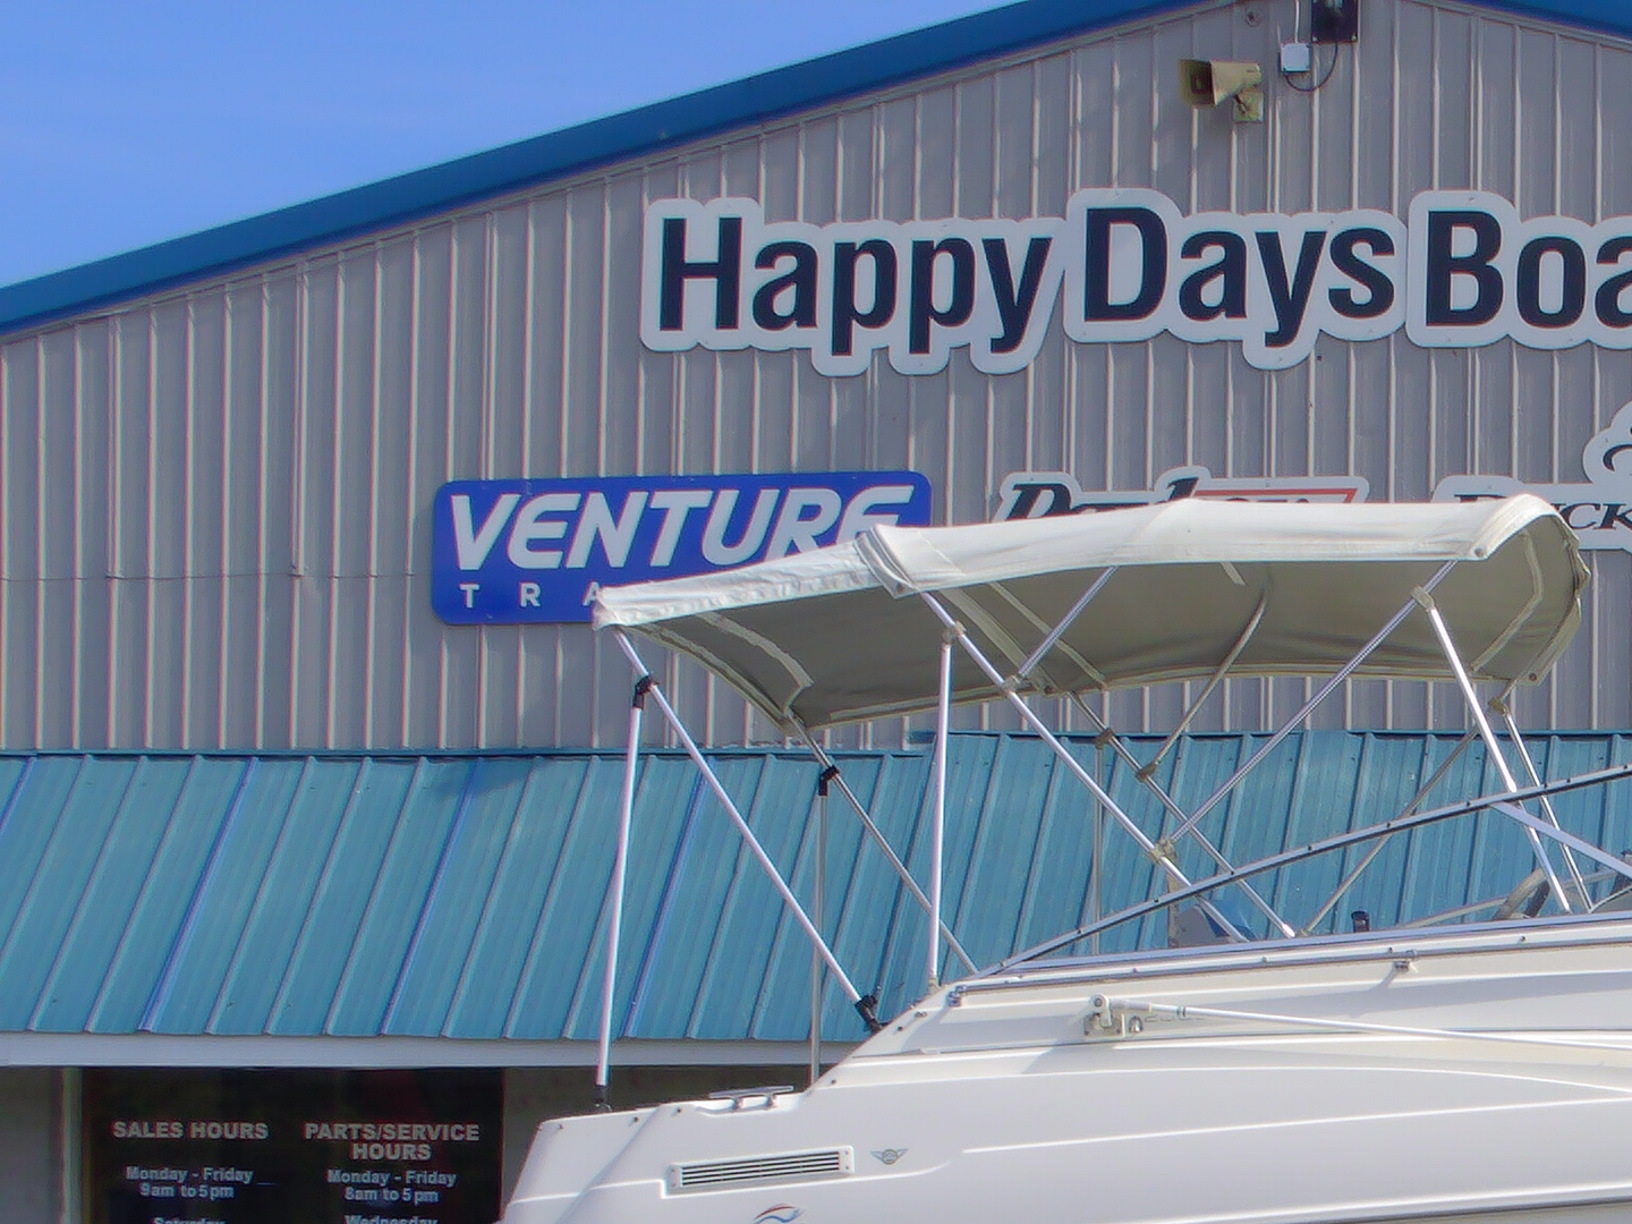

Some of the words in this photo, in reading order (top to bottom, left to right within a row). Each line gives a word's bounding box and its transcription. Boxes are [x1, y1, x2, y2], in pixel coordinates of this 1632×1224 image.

[659, 215, 1053, 357] Happy
[1084, 206, 1396, 348] Days
[113, 1121, 185, 1139] SALES
[190, 1122, 270, 1140] HOURS
[305, 1122, 480, 1141] PARTS/SERVICE
[353, 1143, 432, 1161] HOURS
[126, 1166, 188, 1183] Monday
[203, 1167, 254, 1184] Friday
[327, 1169, 391, 1186] Monday
[405, 1170, 457, 1188] Friday
[180, 1184, 197, 1198] to
[383, 1188, 399, 1201] to
